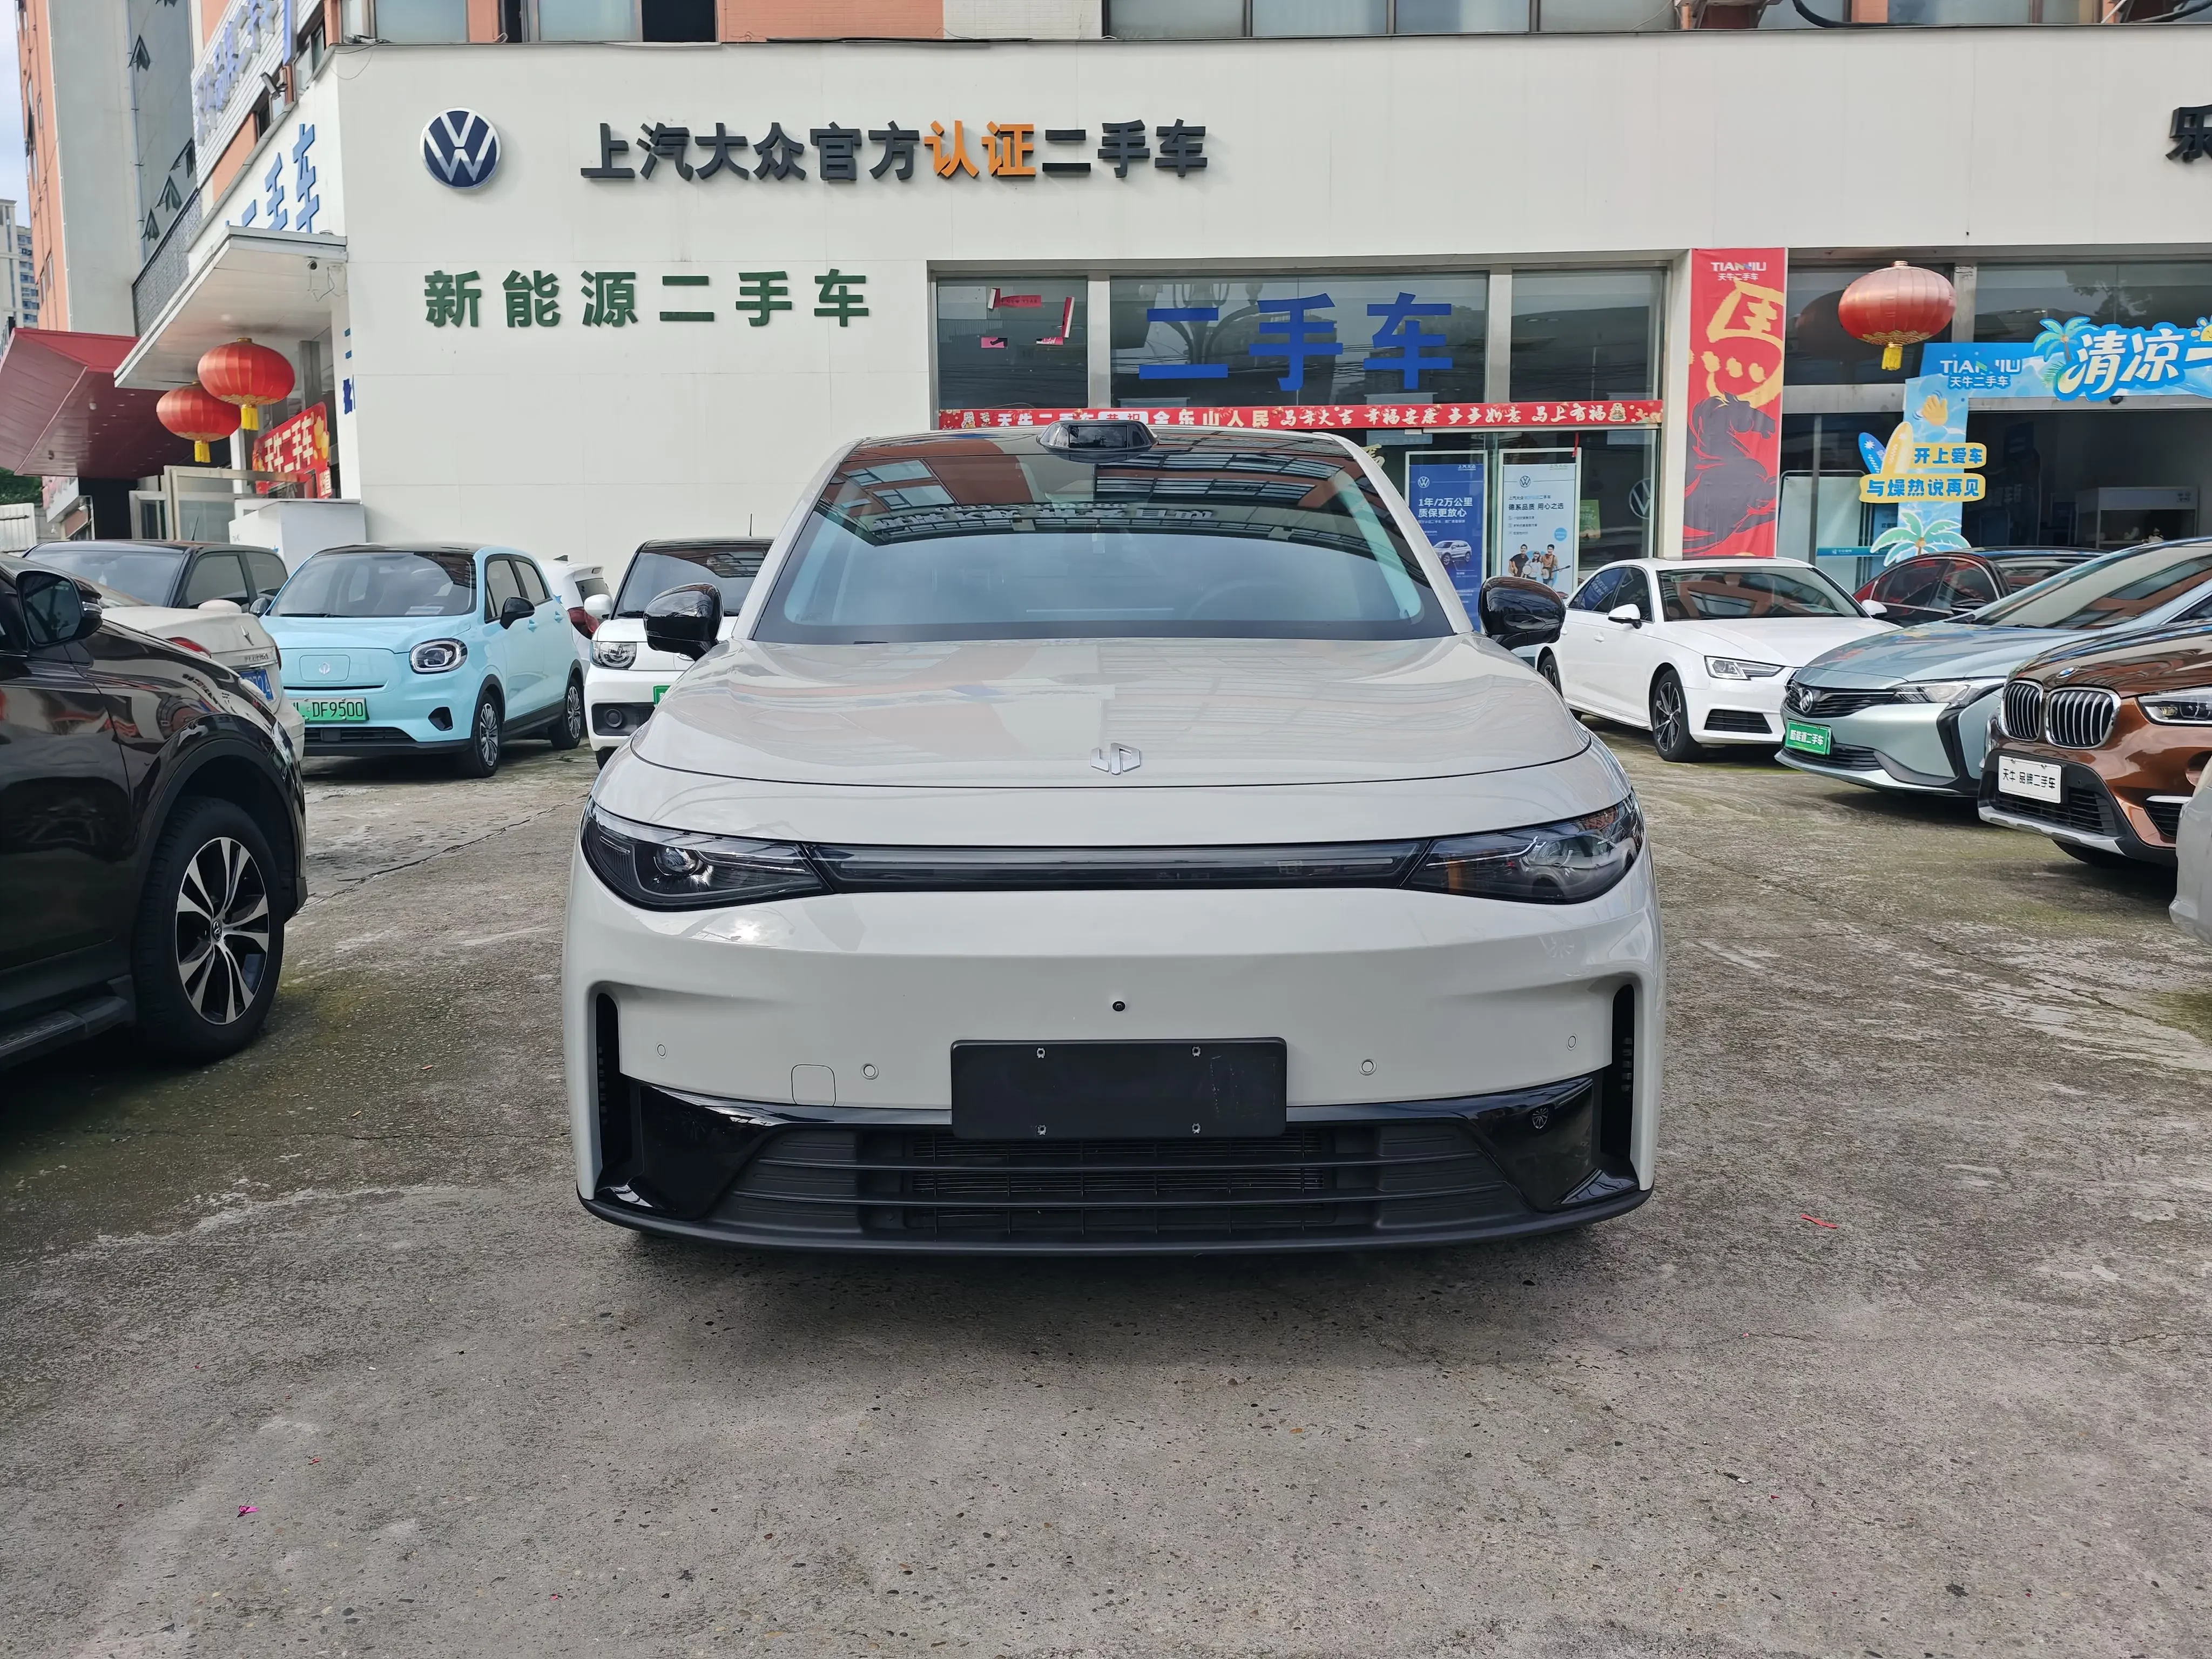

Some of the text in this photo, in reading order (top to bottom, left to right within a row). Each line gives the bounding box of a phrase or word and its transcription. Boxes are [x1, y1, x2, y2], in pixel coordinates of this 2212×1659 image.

[581, 119, 1208, 183] 上汽大众官方认证二手车
[424, 269, 869, 327] 新能源二手车
[1138, 292, 1453, 392] 二手车
[1950, 375, 2009, 387] 天牛二手车
[1914, 447, 1982, 464] 开上爱车
[1867, 478, 1979, 497] 与燥热说再见
[1418, 497, 1473, 507] 1年/2万公里
[1418, 508, 1467, 518] 质保更放心
[312, 702, 363, 717] DF9500
